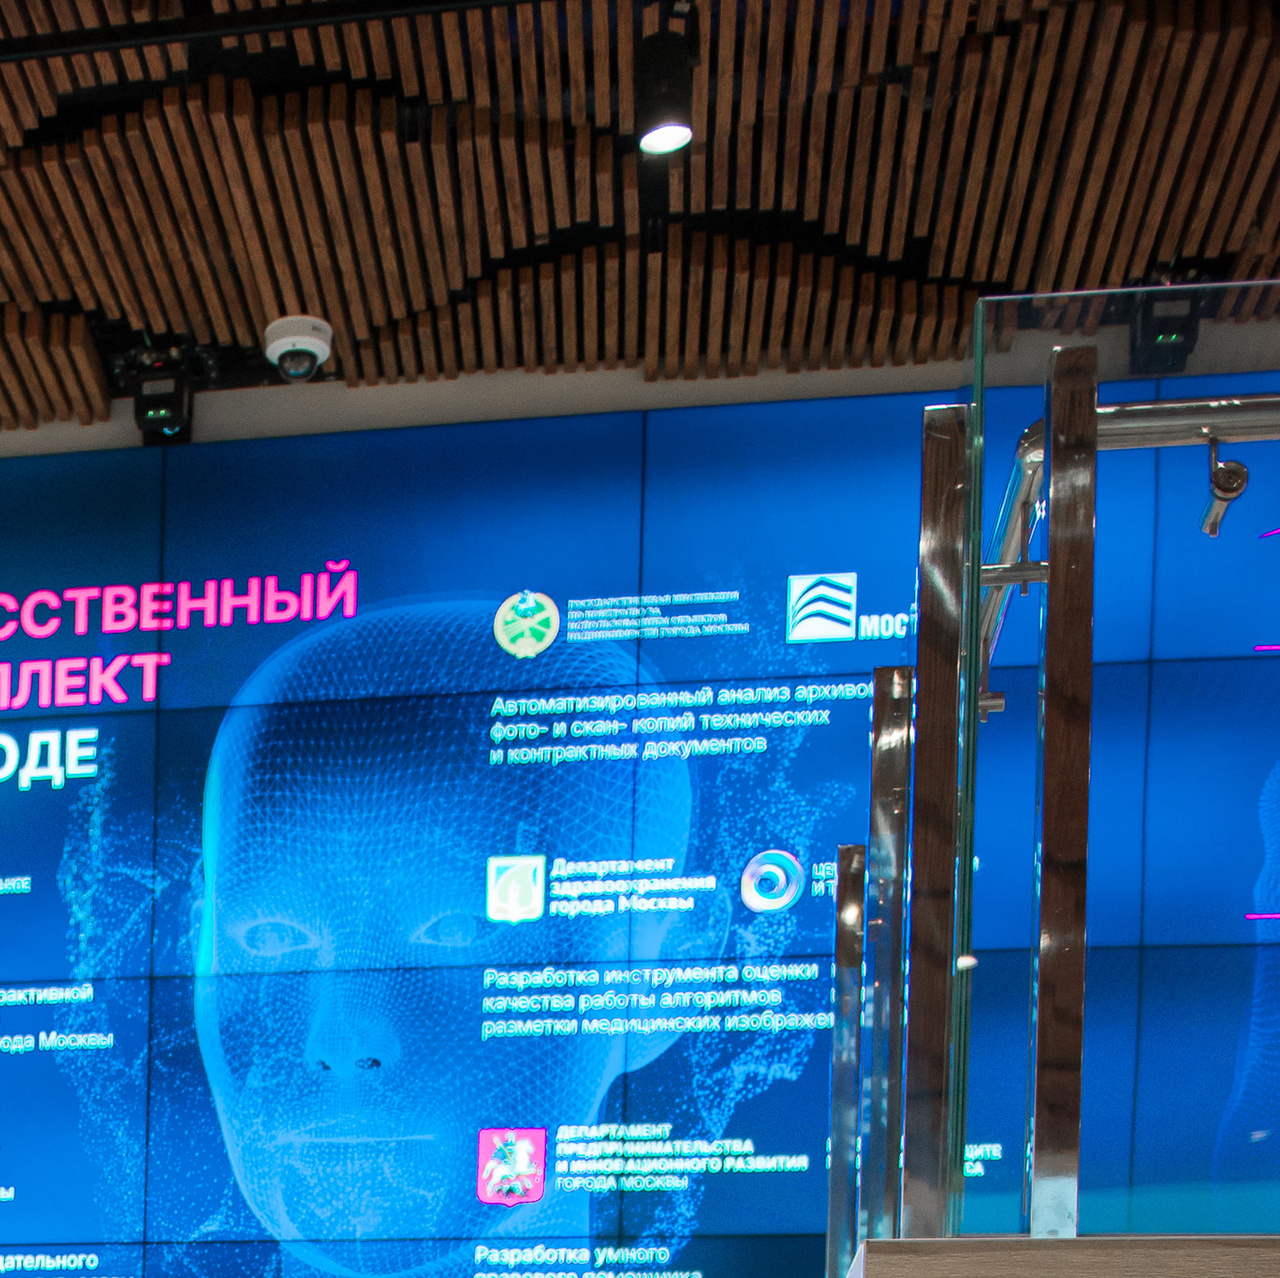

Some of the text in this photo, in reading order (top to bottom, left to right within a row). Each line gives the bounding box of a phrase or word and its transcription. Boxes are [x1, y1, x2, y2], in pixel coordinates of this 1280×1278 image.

[490, 686, 713, 717] Автоматизированный
[717, 684, 790, 706] анализ
[490, 709, 830, 744] фото- и скан- копий технических
[489, 736, 767, 765] и контрактных документов
[549, 857, 675, 880] Департамент
[549, 875, 717, 900] здравоохранения
[549, 896, 694, 919] города Москвы
[483, 963, 819, 992] Разработка инструмента оценки
[482, 989, 782, 1015] качества работы алгоритмов
[481, 1019, 578, 1042] разметки
[581, 1015, 721, 1037] медицинских
[38, 1031, 114, 1051] Москвы
[556, 1124, 672, 1143] ДЕПАРТАМЕНТ
[556, 1139, 755, 1158] ПРЕДПРИНИМАТЕЛЬСТВА
[555, 1154, 809, 1175] И ИННОВАЦИОННОГО РАЗВИТИЯ
[555, 1175, 689, 1193] ГОРОДА МОСКВЫ
[474, 1244, 670, 1268] Разработка умного
